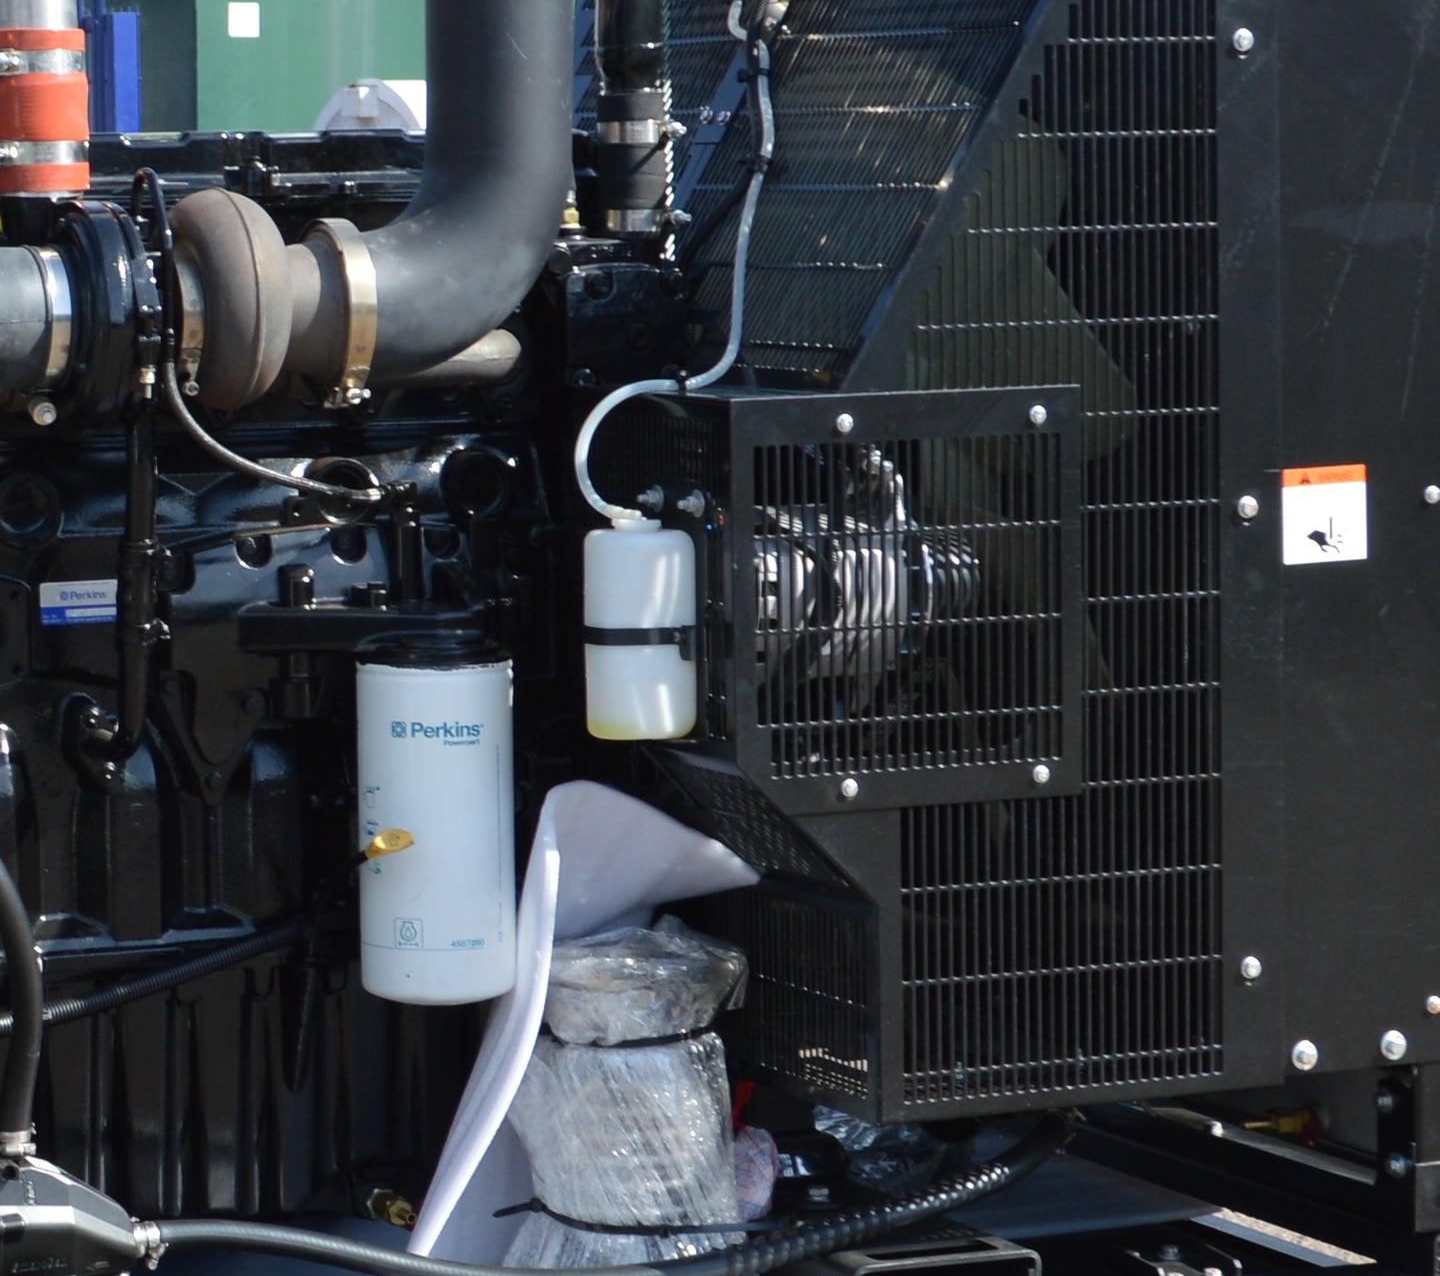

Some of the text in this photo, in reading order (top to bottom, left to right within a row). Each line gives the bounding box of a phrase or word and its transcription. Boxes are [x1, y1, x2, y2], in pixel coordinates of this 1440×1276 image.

[70, 590, 107, 600] Perkins
[410, 721, 481, 738] Perkins
[443, 738, 481, 747] Powerpart
